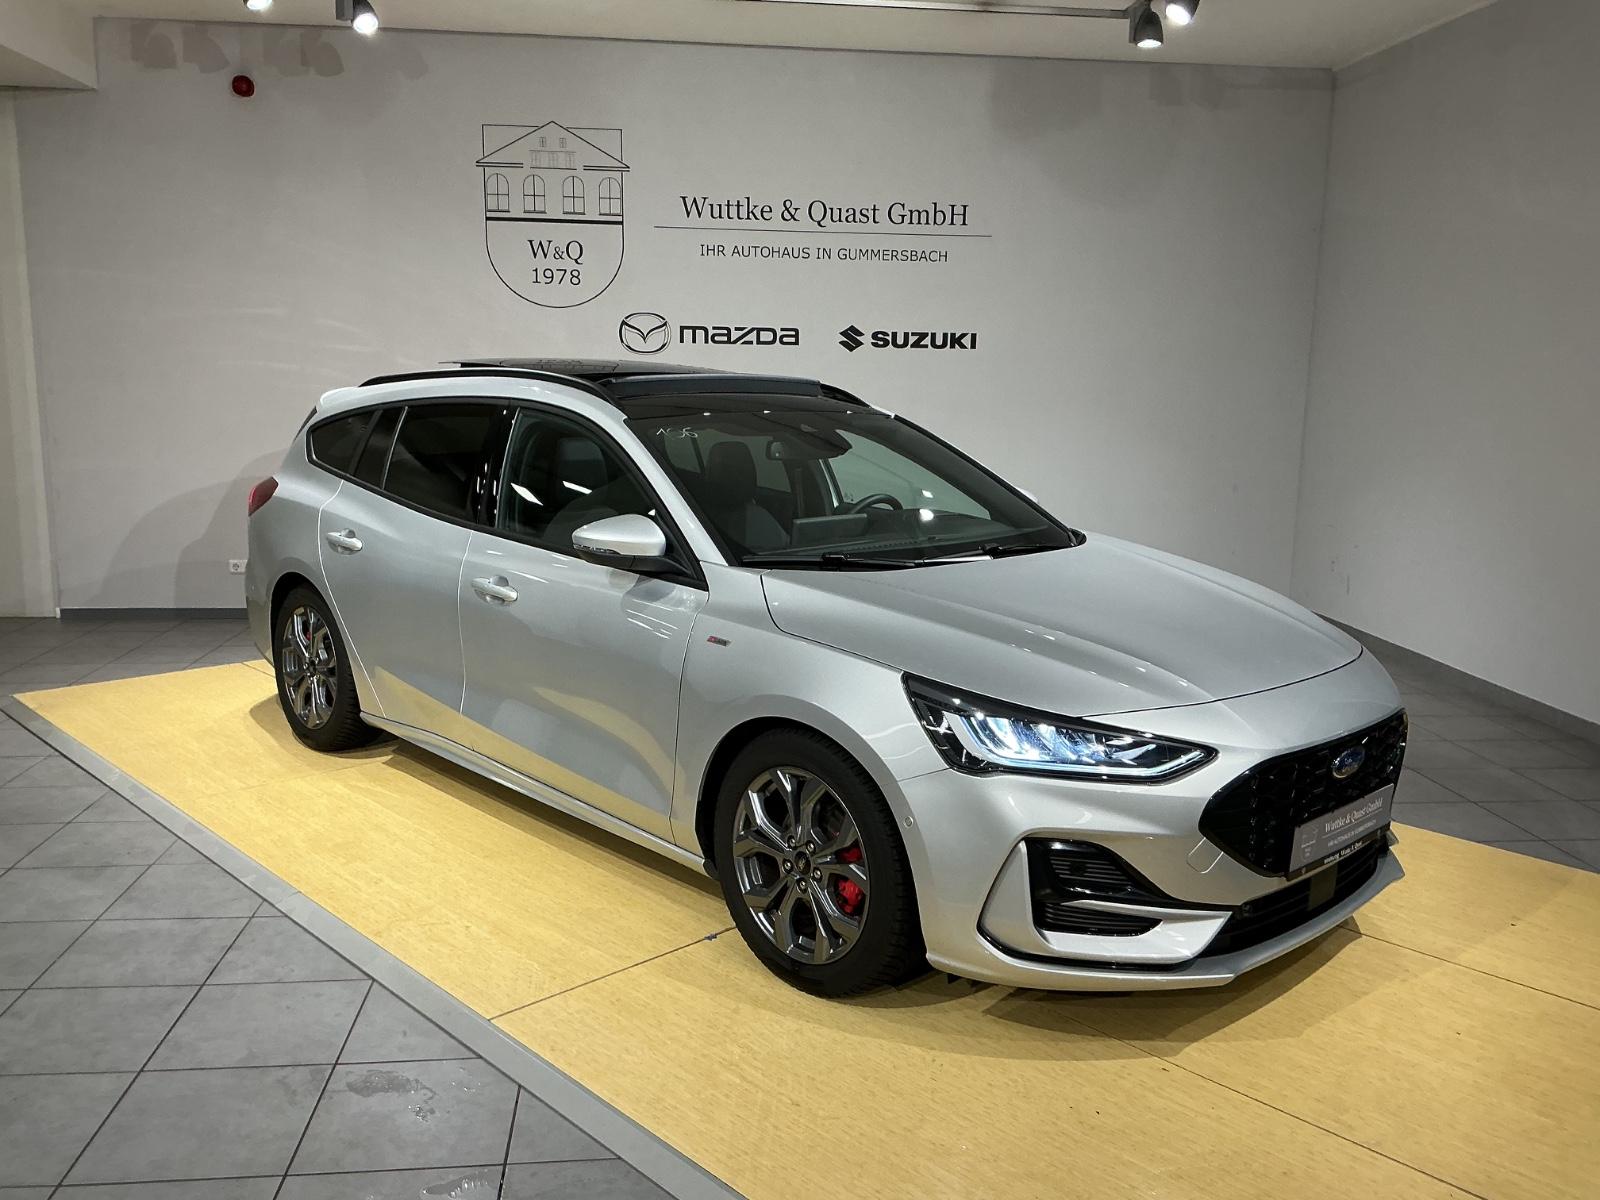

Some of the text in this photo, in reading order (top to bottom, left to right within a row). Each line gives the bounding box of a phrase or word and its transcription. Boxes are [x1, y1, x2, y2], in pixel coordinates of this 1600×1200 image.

[680, 196, 968, 227] Wuttke & Quast GmbH
[528, 240, 583, 264] W&Q
[701, 244, 947, 262] IHR AUTOHAUS IN GUMMERSBACH
[533, 268, 580, 285] 1978
[871, 331, 977, 349] SUZUKI
